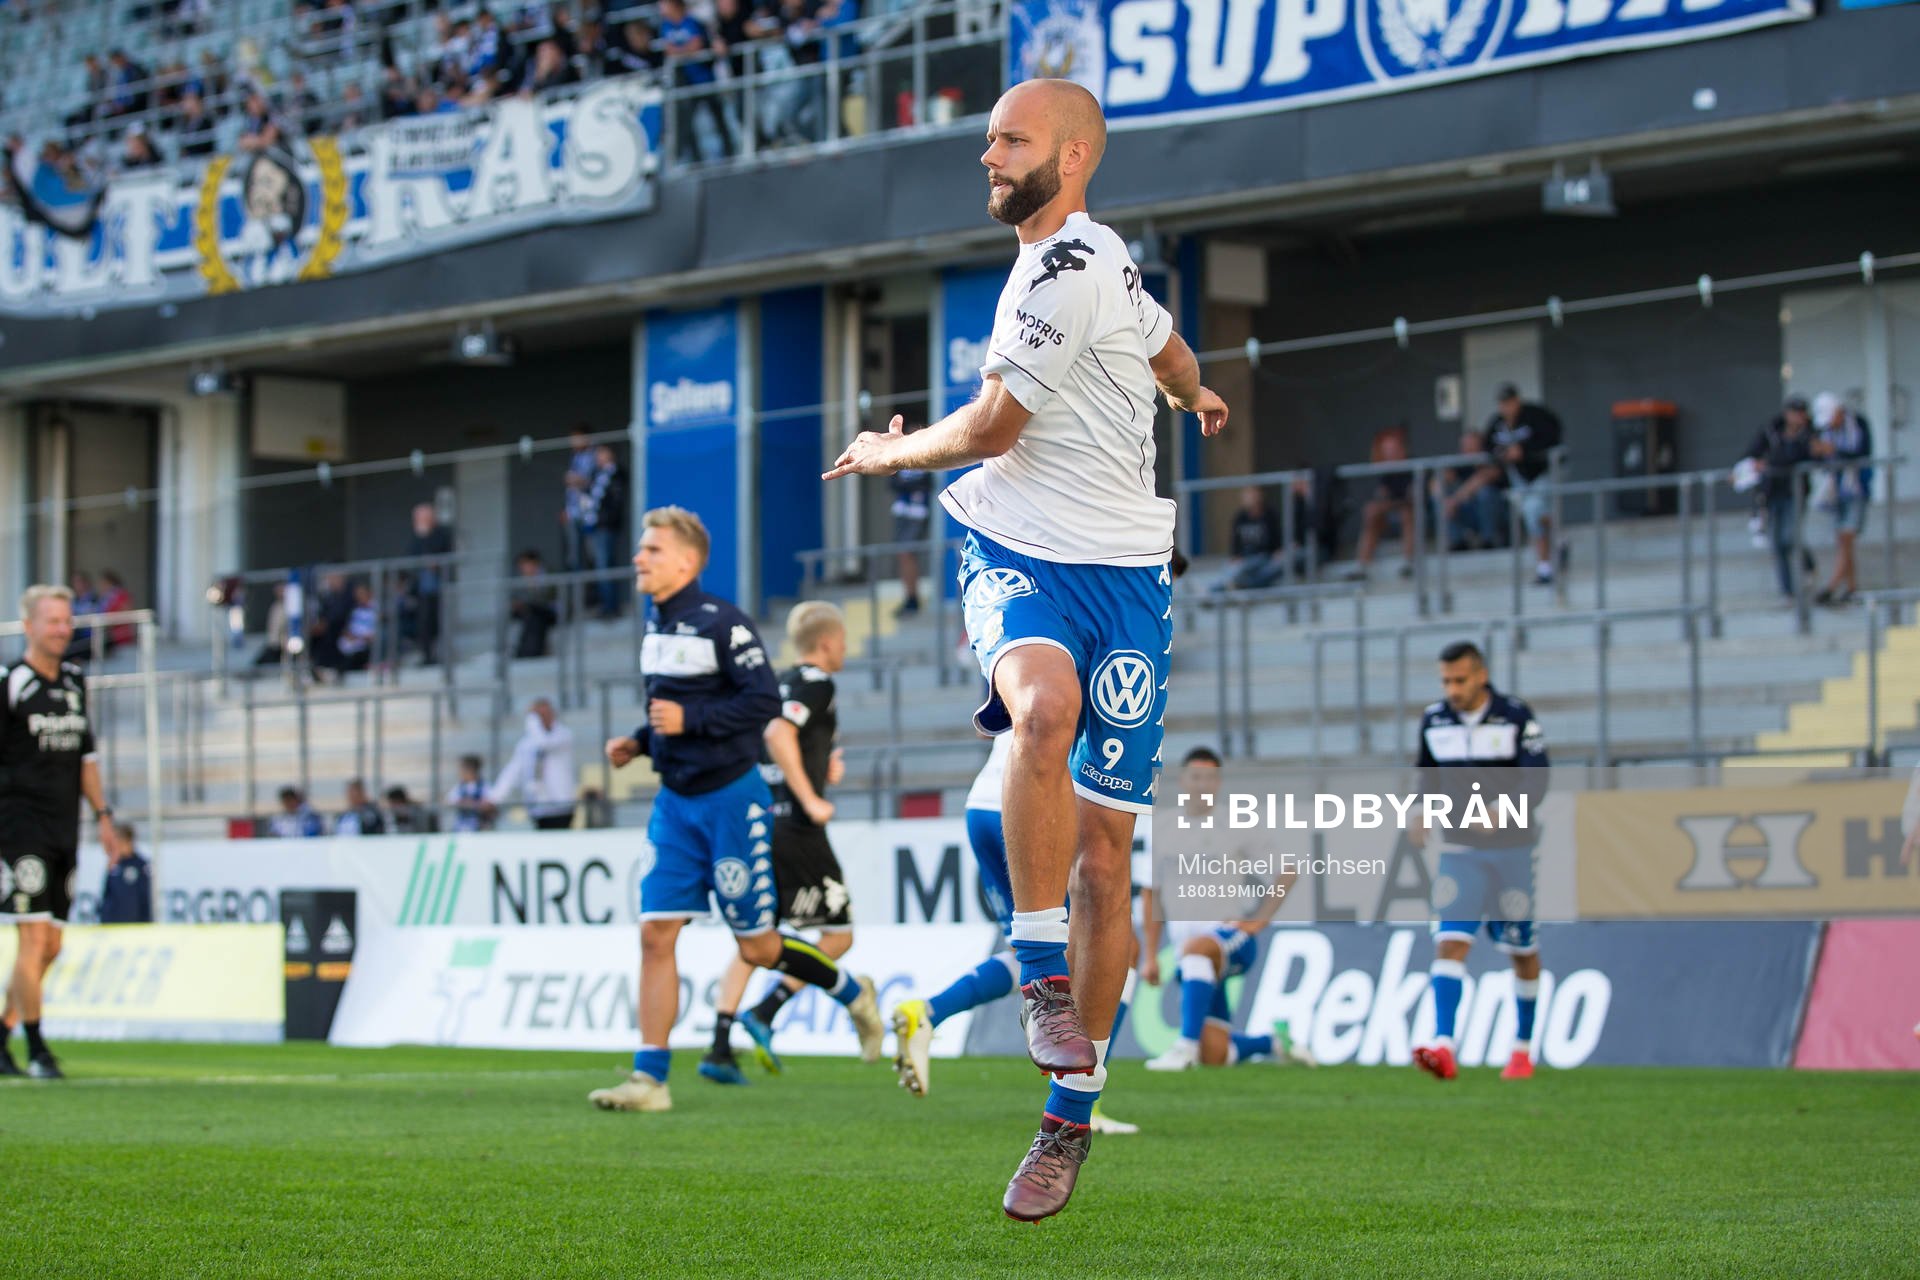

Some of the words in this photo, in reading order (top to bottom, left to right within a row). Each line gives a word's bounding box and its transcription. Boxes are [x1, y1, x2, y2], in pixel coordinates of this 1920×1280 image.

[1019, 328, 1046, 350] LW
[1096, 655, 1153, 722] VW
[1081, 762, 1133, 791] Kappa
[1102, 737, 1124, 770] 9
[1843, 816, 1911, 879] H
[491, 859, 612, 925] NRC
